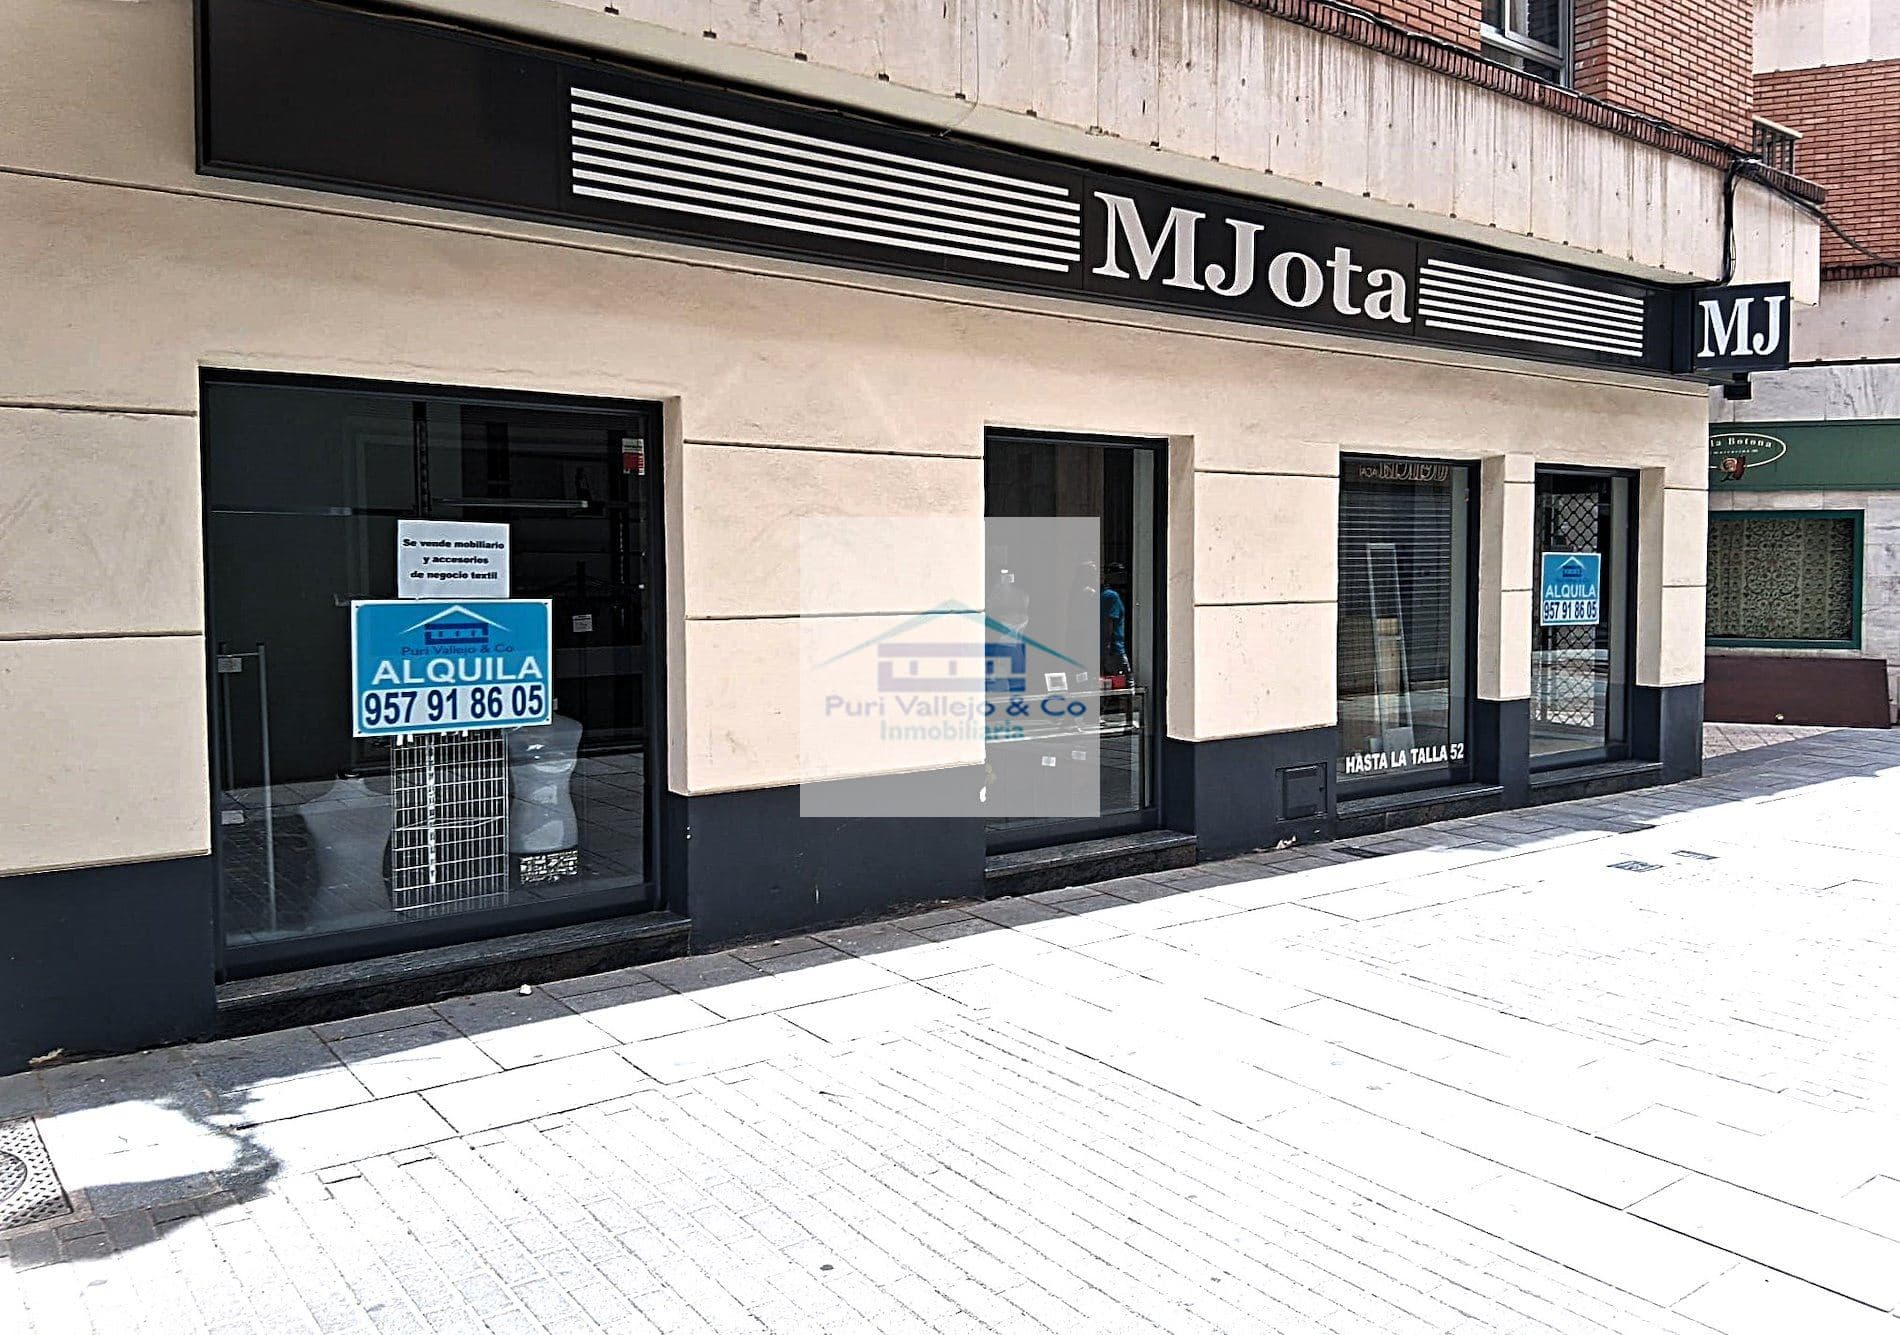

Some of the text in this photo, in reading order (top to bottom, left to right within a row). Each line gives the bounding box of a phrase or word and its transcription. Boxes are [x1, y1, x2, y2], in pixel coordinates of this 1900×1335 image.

[1092, 191, 1412, 324] MJota
[1697, 295, 1786, 358] MJ
[403, 539, 505, 549] Se vende mobiliario
[423, 556, 490, 565] y accesorios
[410, 571, 425, 579] de
[427, 571, 469, 580] negocio
[1544, 584, 1597, 598] ALQUILA
[1544, 601, 1597, 619] 957 91 86 05
[401, 646, 429, 656] Puri
[433, 645, 474, 656] Vallejo
[495, 644, 513, 653] Co
[372, 656, 544, 685] ALQUILA
[364, 685, 543, 726] 957 91 86 05
[1345, 743, 1464, 774] HASTA LA TALLA 52
